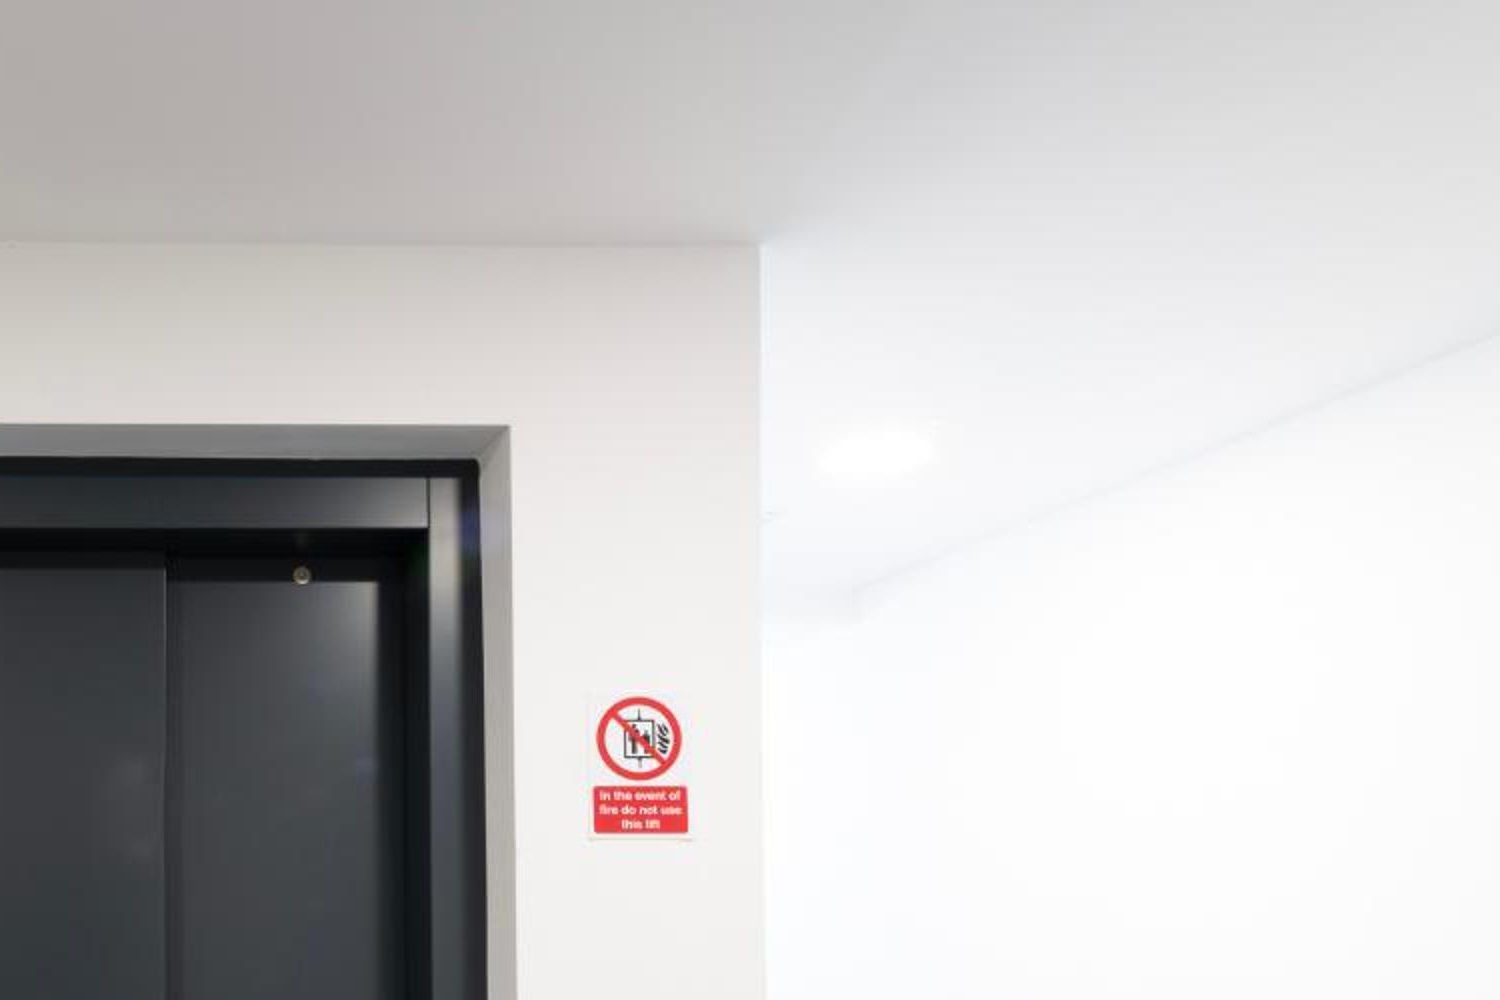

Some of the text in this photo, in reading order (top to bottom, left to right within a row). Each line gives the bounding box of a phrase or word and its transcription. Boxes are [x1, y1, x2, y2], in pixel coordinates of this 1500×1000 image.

[614, 791, 632, 801] the
[635, 791, 666, 801] event
[668, 790, 680, 801] of
[599, 804, 683, 815] fire do not use
[621, 819, 660, 829] this lift
